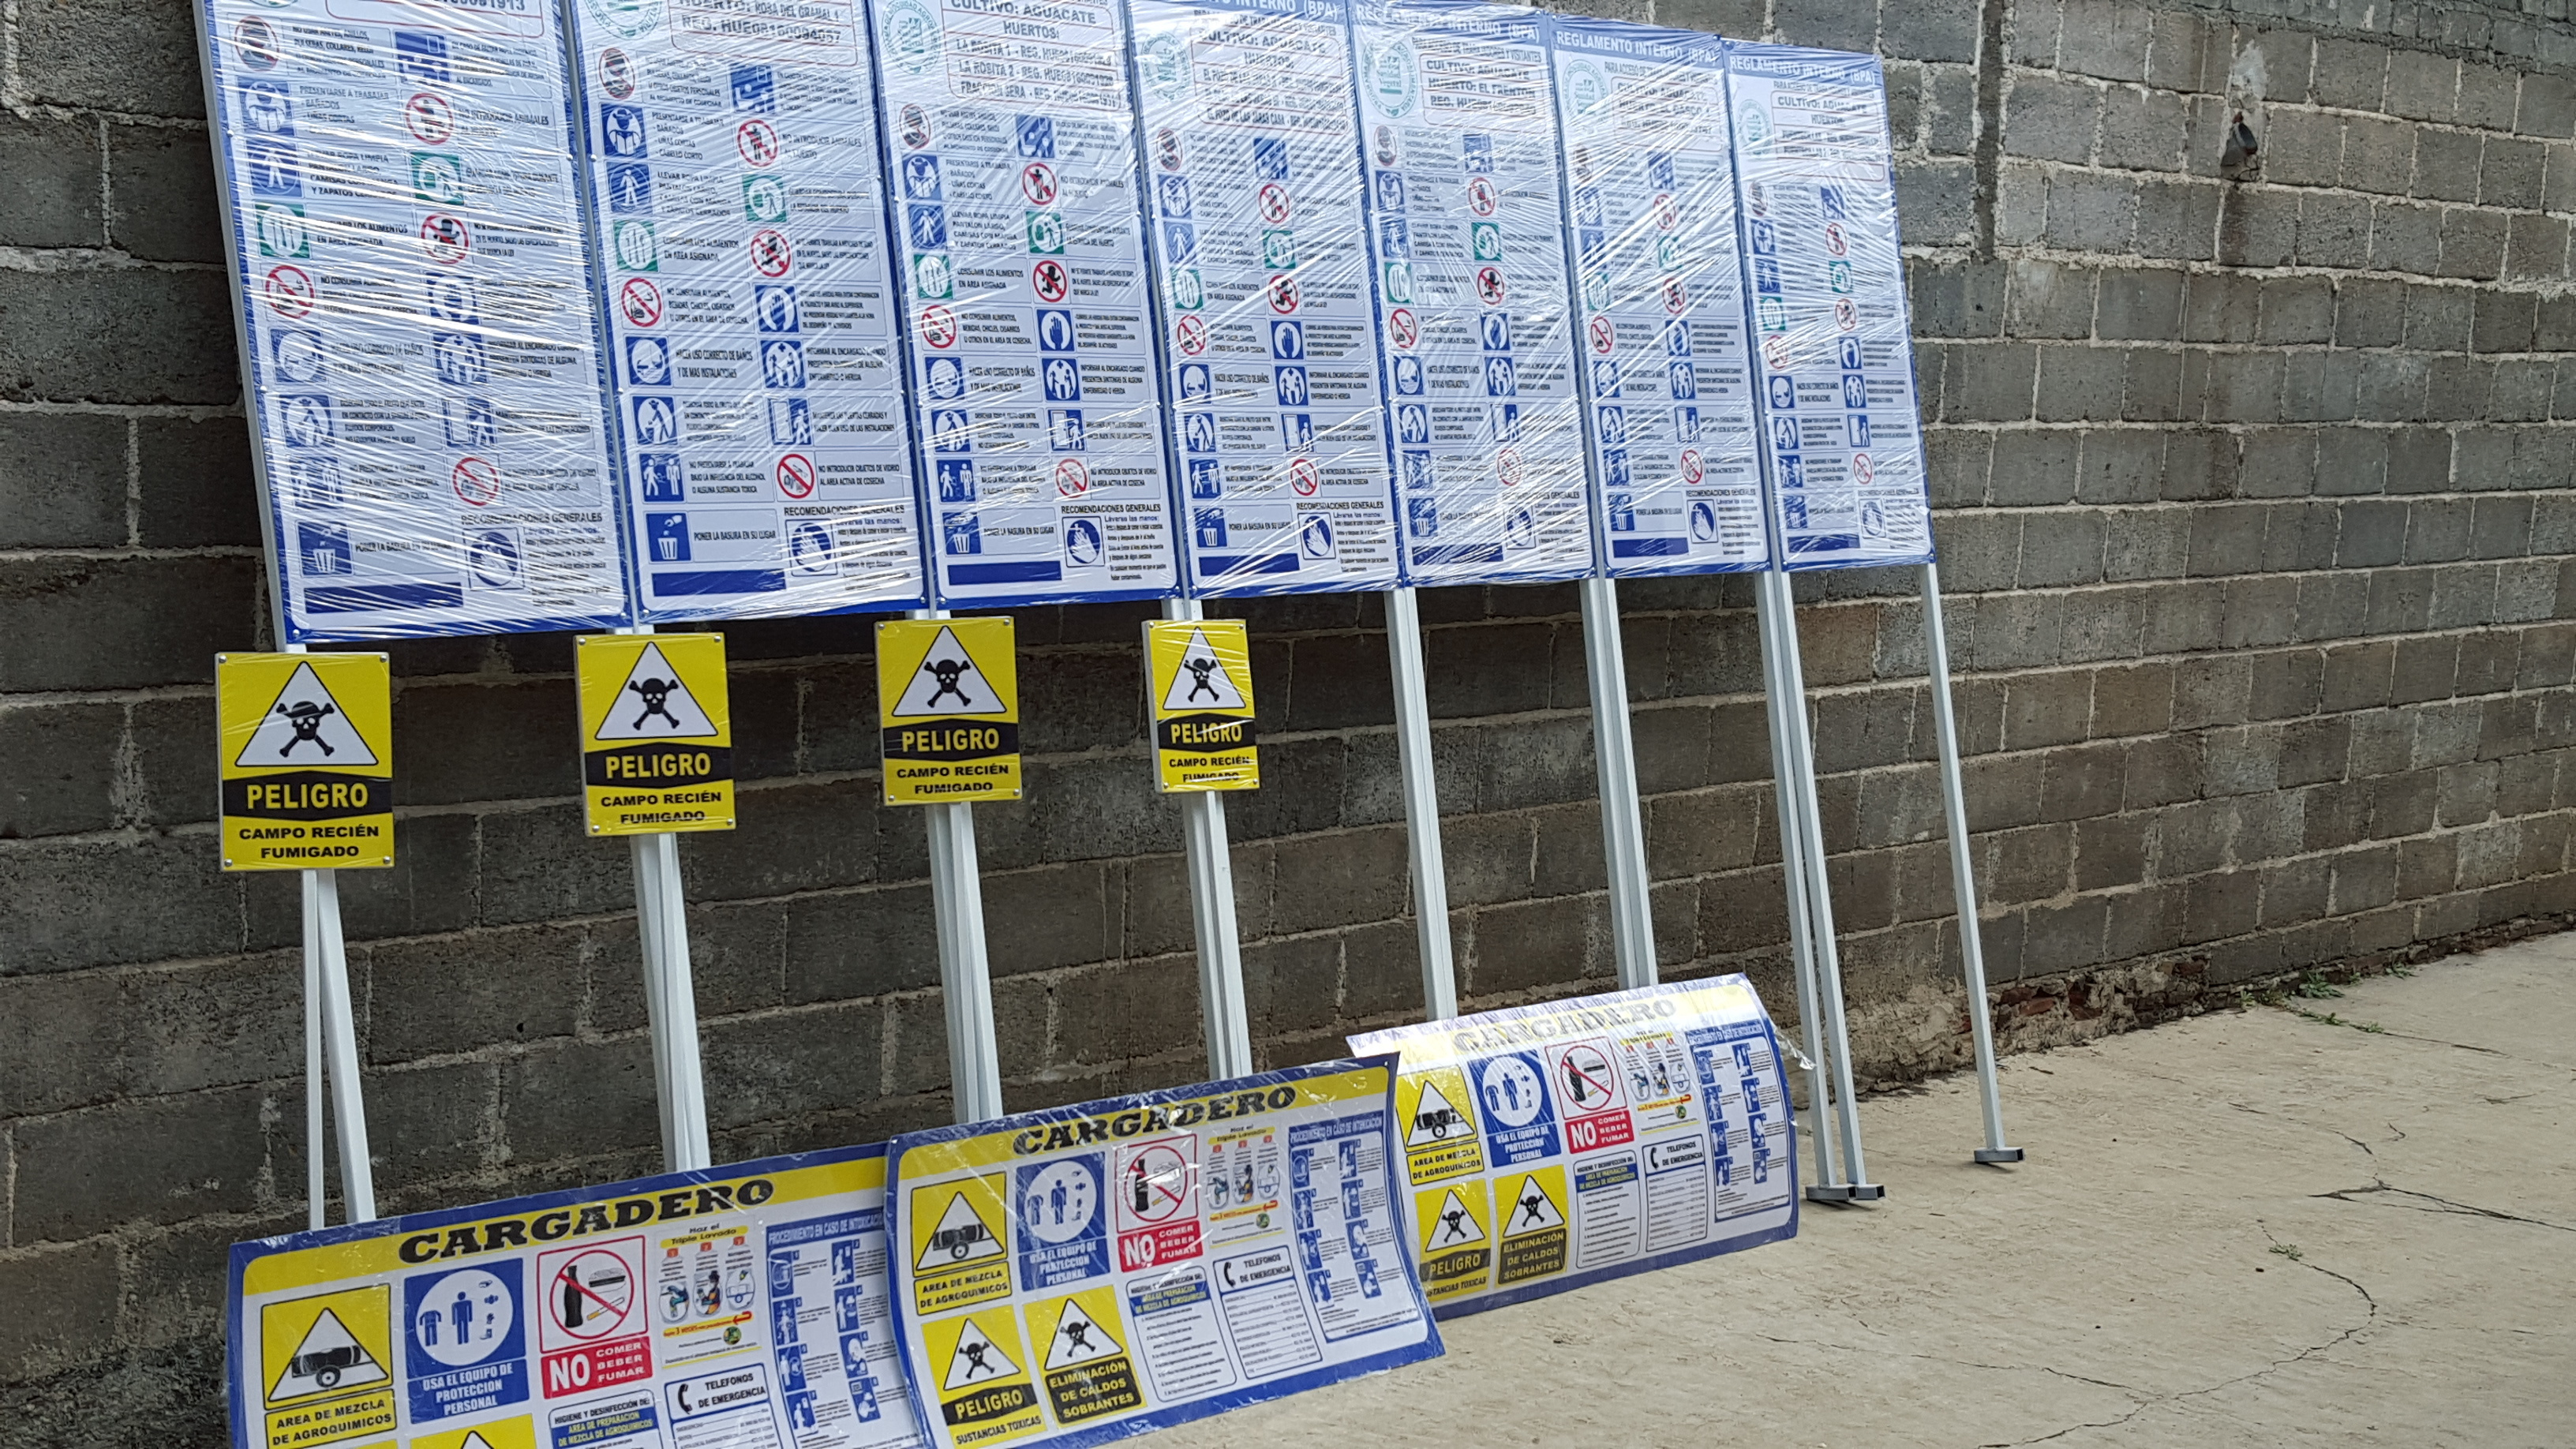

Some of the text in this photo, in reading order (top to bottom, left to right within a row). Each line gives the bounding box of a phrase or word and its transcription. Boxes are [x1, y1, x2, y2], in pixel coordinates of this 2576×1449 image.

[1024, 4, 1096, 24] AGUACATE
[1003, 21, 1059, 39] HUERTOS:
[1556, 31, 1634, 53] REGLAMENTO
[1635, 41, 1683, 58] INTERNO
[1061, 504, 1124, 514] RECOMENDACIONES
[901, 728, 999, 752] PELIGRO
[1170, 723, 1242, 743] PELIGRO
[605, 752, 711, 779] PELIGRO
[1169, 755, 1249, 767] CAMPO RECIÉN
[897, 763, 1009, 778] CAMPO RECIÉN
[1182, 772, 1240, 783] FUMIGADO
[247, 783, 369, 809] PELIGRO
[915, 782, 993, 794] FUMIGADO
[601, 790, 721, 807] CAMPO RECIÉN
[620, 811, 705, 824] FUMIGADO
[239, 824, 379, 839] CAMPO RECIÉN
[261, 846, 359, 859] FUMIGADO
[1453, 999, 1676, 1052] CARGADERO
[1012, 1085, 1297, 1156] CARGADERO
[1597, 1114, 1626, 1125] COMER
[1599, 1123, 1627, 1134] BEBER
[1496, 1133, 1509, 1144] USA
[1518, 1128, 1540, 1139] EQUIPO
[1542, 1125, 1549, 1134] DE
[1570, 1121, 1597, 1148] NO
[1601, 1133, 1629, 1144] FUMAR
[1511, 1149, 1542, 1163] PERSONAL
[1667, 1141, 1696, 1153] TELEFONOS
[1414, 1148, 1476, 1166] AREA DE MEZCLA
[1670, 1151, 1703, 1165] EMERGENCIA
[1413, 1170, 1423, 1179] DE
[399, 1178, 774, 1264] CARGADERO
[824, 1220, 839, 1235] CASO
[841, 1219, 848, 1232] DE
[671, 1228, 736, 1245] Triple Lavado
[1159, 1225, 1194, 1237] COMER
[1047, 1249, 1055, 1260] EL
[1056, 1244, 1086, 1258] EQUIPO
[1088, 1241, 1097, 1251] DE
[1124, 1234, 1155, 1267] NO
[1159, 1235, 1195, 1249] BEBER
[1503, 1231, 1563, 1253] ELIMINACIÓN
[1162, 1245, 1196, 1260] FUMAR
[1244, 1253, 1281, 1268] TELEFONOS
[1507, 1247, 1559, 1266] DE CALDOS
[1429, 1253, 1481, 1276] PELIGRO
[1503, 1259, 1559, 1279] SOBRANTES
[923, 1270, 1002, 1293] AREA DE MEZCLA
[1046, 1267, 1087, 1286] PERSONAL
[1240, 1265, 1291, 1283] DE EMERGENCIA
[1461, 1276, 1487, 1289] TOXICAS
[920, 1282, 1008, 1308] DE AGROQUIMICOS
[596, 1342, 642, 1357] COMER
[597, 1354, 642, 1370] BEBER
[422, 1363, 513, 1391] USA EL EQUIPO DE
[549, 1354, 590, 1391] NO
[597, 1366, 645, 1383] FUMAR
[1050, 1360, 1127, 1389] ELIMINACIÓN
[436, 1379, 503, 1403] PROTECCION
[705, 1373, 754, 1391] TELEFONOS
[1061, 1378, 1126, 1402] DE CALDOS
[444, 1395, 498, 1416] PERSONAL
[639, 1398, 650, 1406] DE:
[698, 1386, 766, 1408] DE EMERGENCIA
[955, 1389, 1024, 1420] PELIGRO
[1063, 1392, 1134, 1419] SOBRANTES
[276, 1399, 385, 1428] AREA DE MEZCLA
[272, 1413, 391, 1446] DE AGROQUIMICOS
[956, 1415, 1042, 1445] SUSTANCIAS TOXICAS
[559, 1438, 567, 1447] DE
